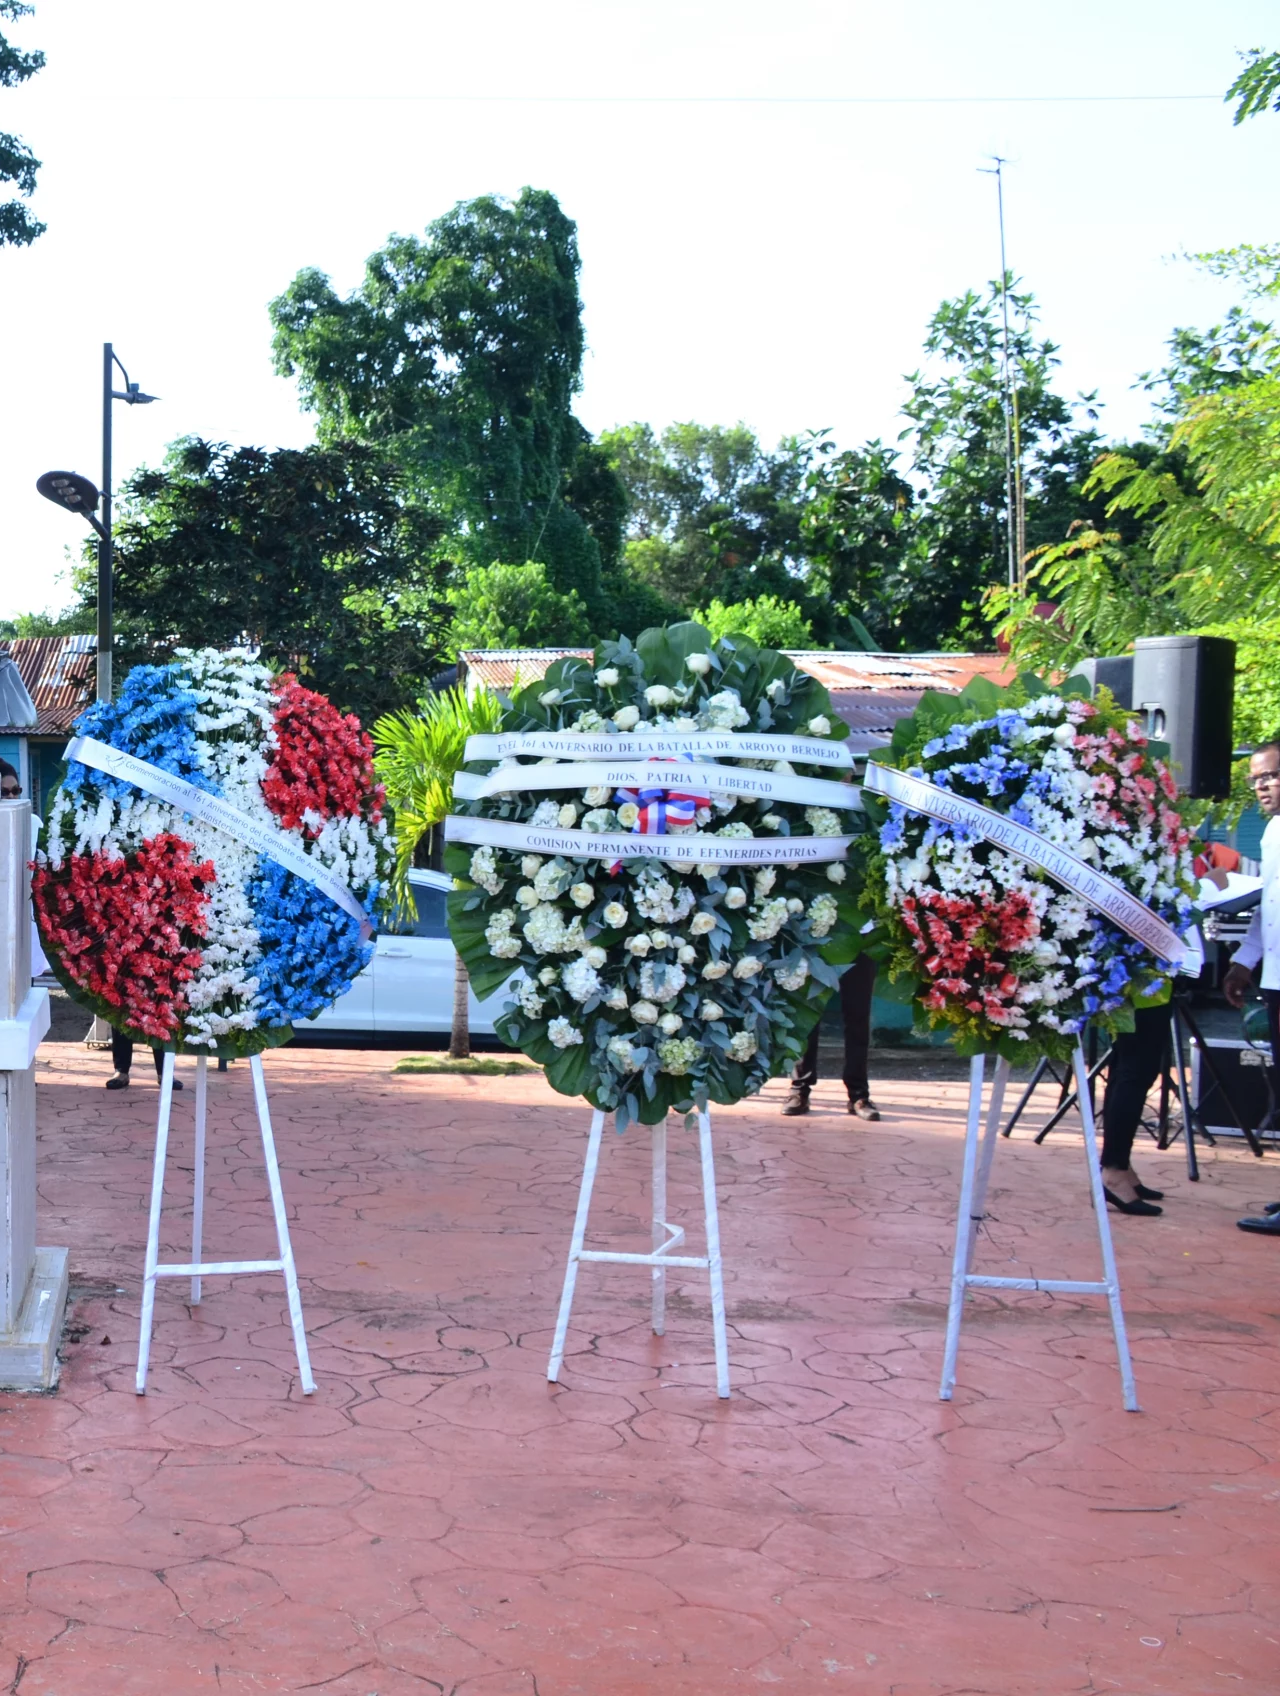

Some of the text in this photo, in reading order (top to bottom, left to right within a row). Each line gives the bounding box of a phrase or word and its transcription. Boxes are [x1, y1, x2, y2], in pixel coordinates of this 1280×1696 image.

[508, 740, 517, 750] EL
[521, 739, 536, 748] 161
[540, 740, 613, 753] ANIVERSARIO
[619, 742, 633, 753] DE
[639, 742, 653, 752] LA
[657, 741, 713, 752] BATALLA
[716, 741, 732, 750] DE
[738, 742, 786, 754] ARROYO
[792, 745, 840, 760] BERMEJO
[607, 772, 772, 793] DIOS, PATRIA Y LIBERTAD
[125, 761, 181, 793] Conmemoración
[182, 786, 192, 797] al
[192, 793, 205, 805] 161
[207, 801, 249, 829] Aniversario
[249, 824, 262, 837] del
[263, 833, 296, 857] Combate
[295, 854, 306, 865] de
[306, 862, 329, 880] Arroyo
[199, 810, 236, 835] Ministerio
[237, 831, 248, 841] de
[526, 835, 818, 859] COMISION PERMANENTE DE EFEMERIDES PATRIAS
[916, 790, 994, 834] ANIVERSARIO
[992, 824, 1014, 844] DE
[1010, 831, 1028, 853] LA
[1029, 842, 1081, 887] BATALLA
[1082, 879, 1103, 899] DE
[1100, 893, 1147, 931] ARROLLO
